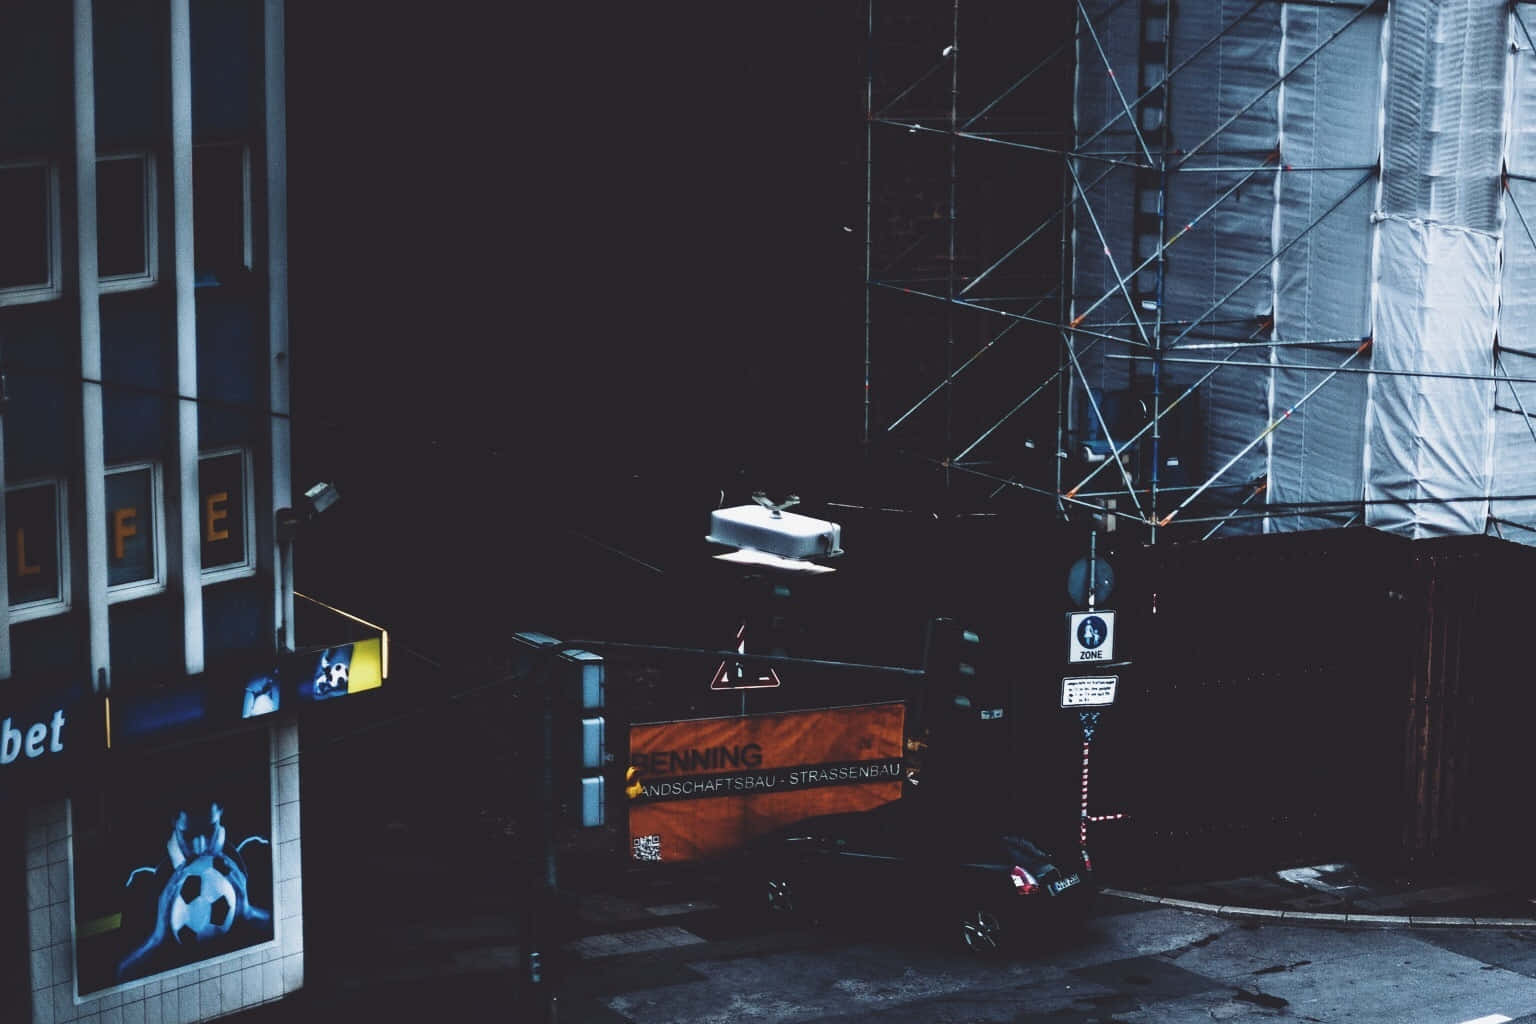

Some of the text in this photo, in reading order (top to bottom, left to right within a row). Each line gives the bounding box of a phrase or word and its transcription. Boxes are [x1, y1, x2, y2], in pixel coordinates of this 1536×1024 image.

[1080, 650, 1103, 660] ZONE
[0, 709, 65, 765] bet
[638, 775, 776, 798] ANDSCHAFTSBAU
[789, 763, 900, 785] STRASSENBAU
